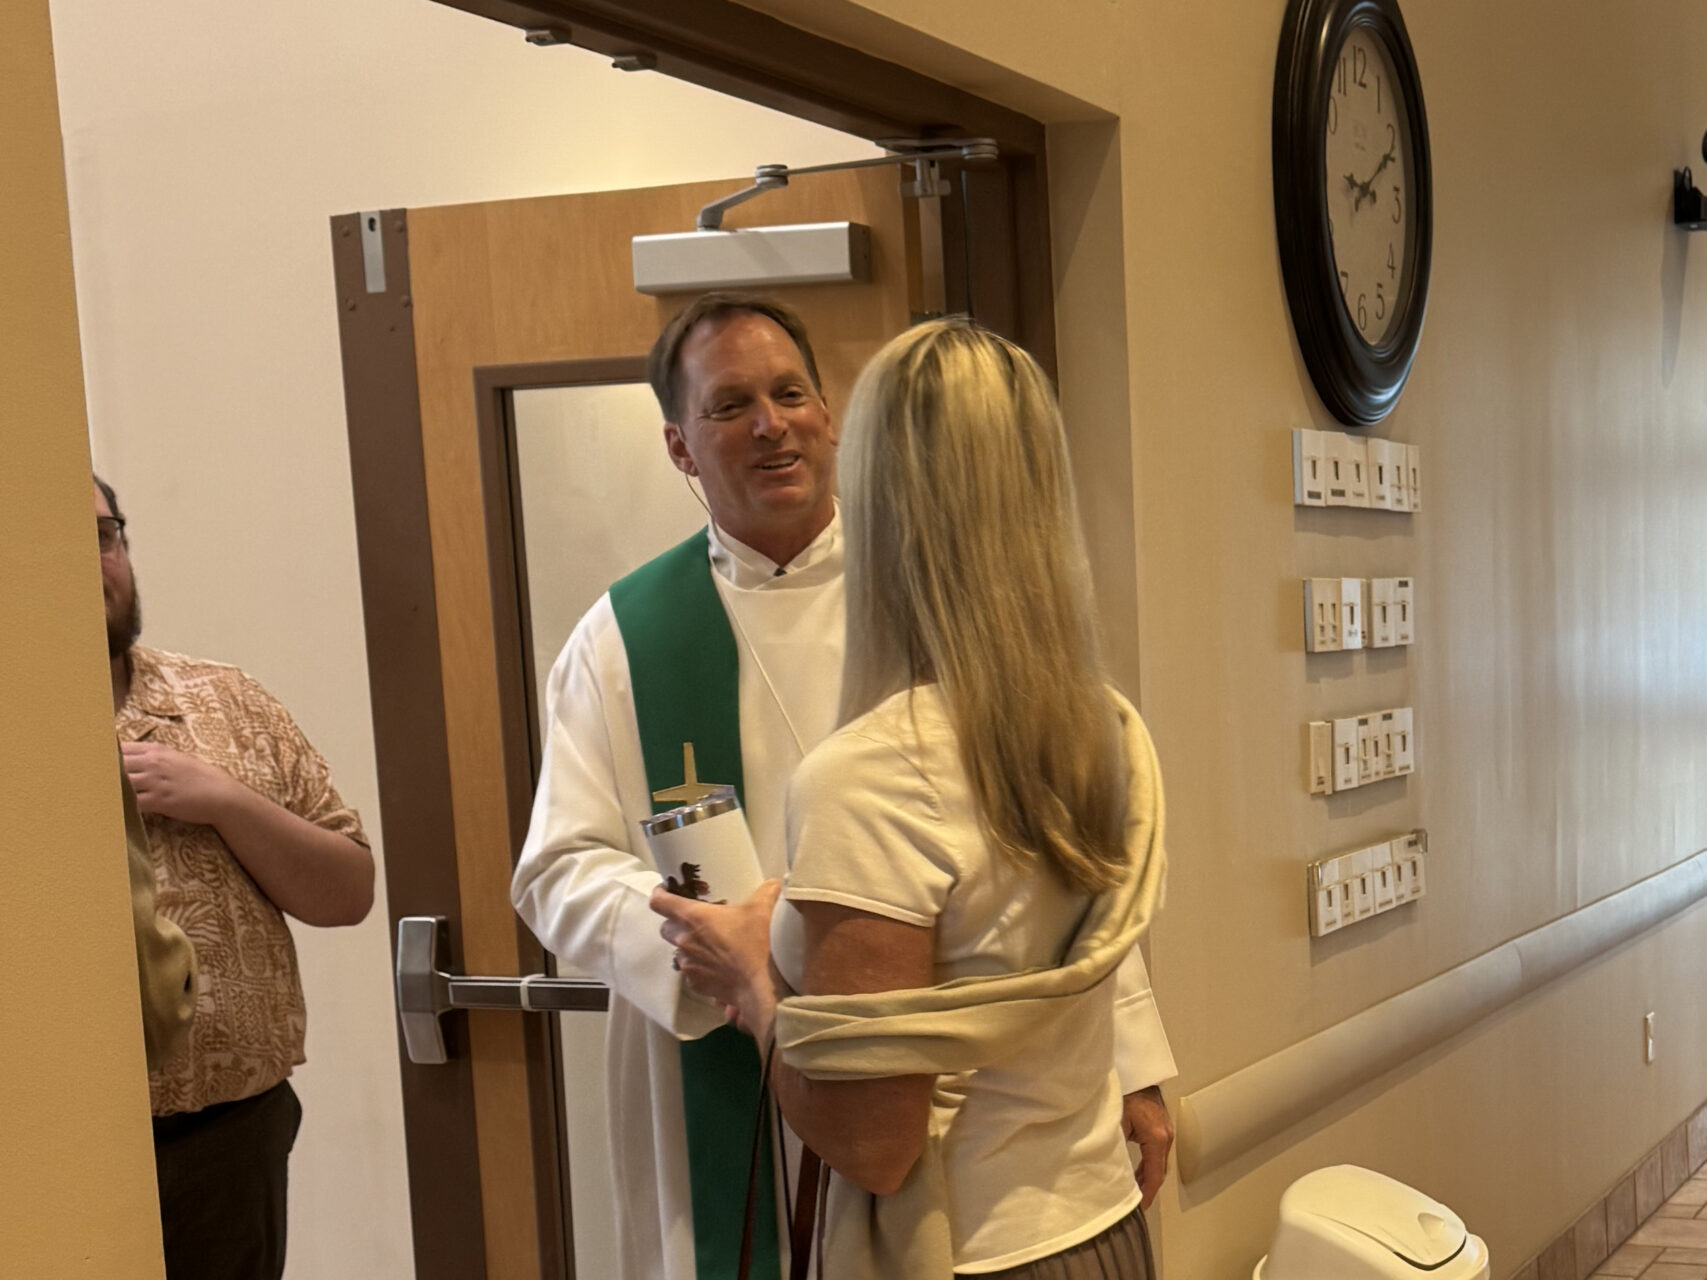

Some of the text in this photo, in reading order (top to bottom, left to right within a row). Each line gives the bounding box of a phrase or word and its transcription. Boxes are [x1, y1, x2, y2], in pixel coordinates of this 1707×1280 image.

[1338, 56, 1347, 97] 11
[1353, 45, 1367, 88] 12
[1376, 75, 1381, 114] 1
[1328, 96, 1338, 135] 0
[1386, 123, 1396, 162] 2
[1392, 185, 1402, 224] 3
[1387, 242, 1396, 279] 4
[1358, 293, 1367, 331] 6
[1376, 283, 1385, 320] 5
